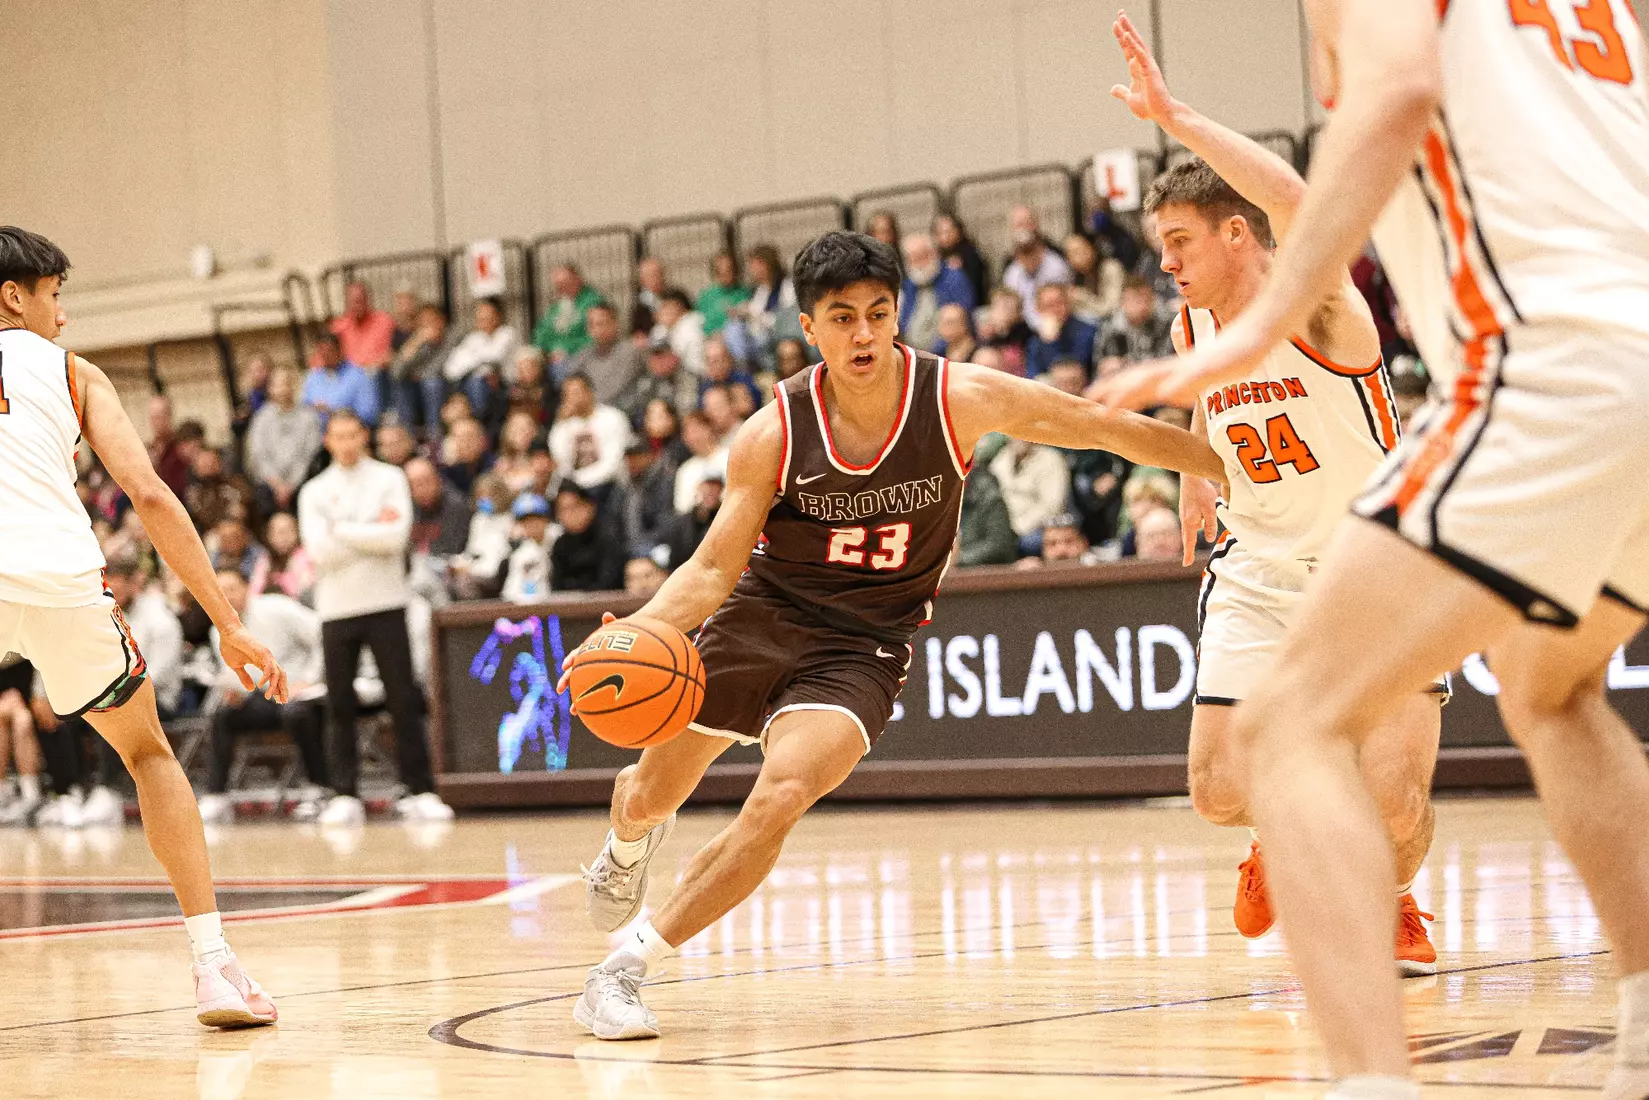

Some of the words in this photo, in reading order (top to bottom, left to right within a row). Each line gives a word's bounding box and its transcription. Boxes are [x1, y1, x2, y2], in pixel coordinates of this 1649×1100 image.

[1207, 378, 1308, 419] PRINCETON
[1226, 412, 1320, 484] 24
[799, 475, 943, 520] BROWN
[825, 521, 912, 571] 23
[925, 624, 1196, 719] ISLAND
